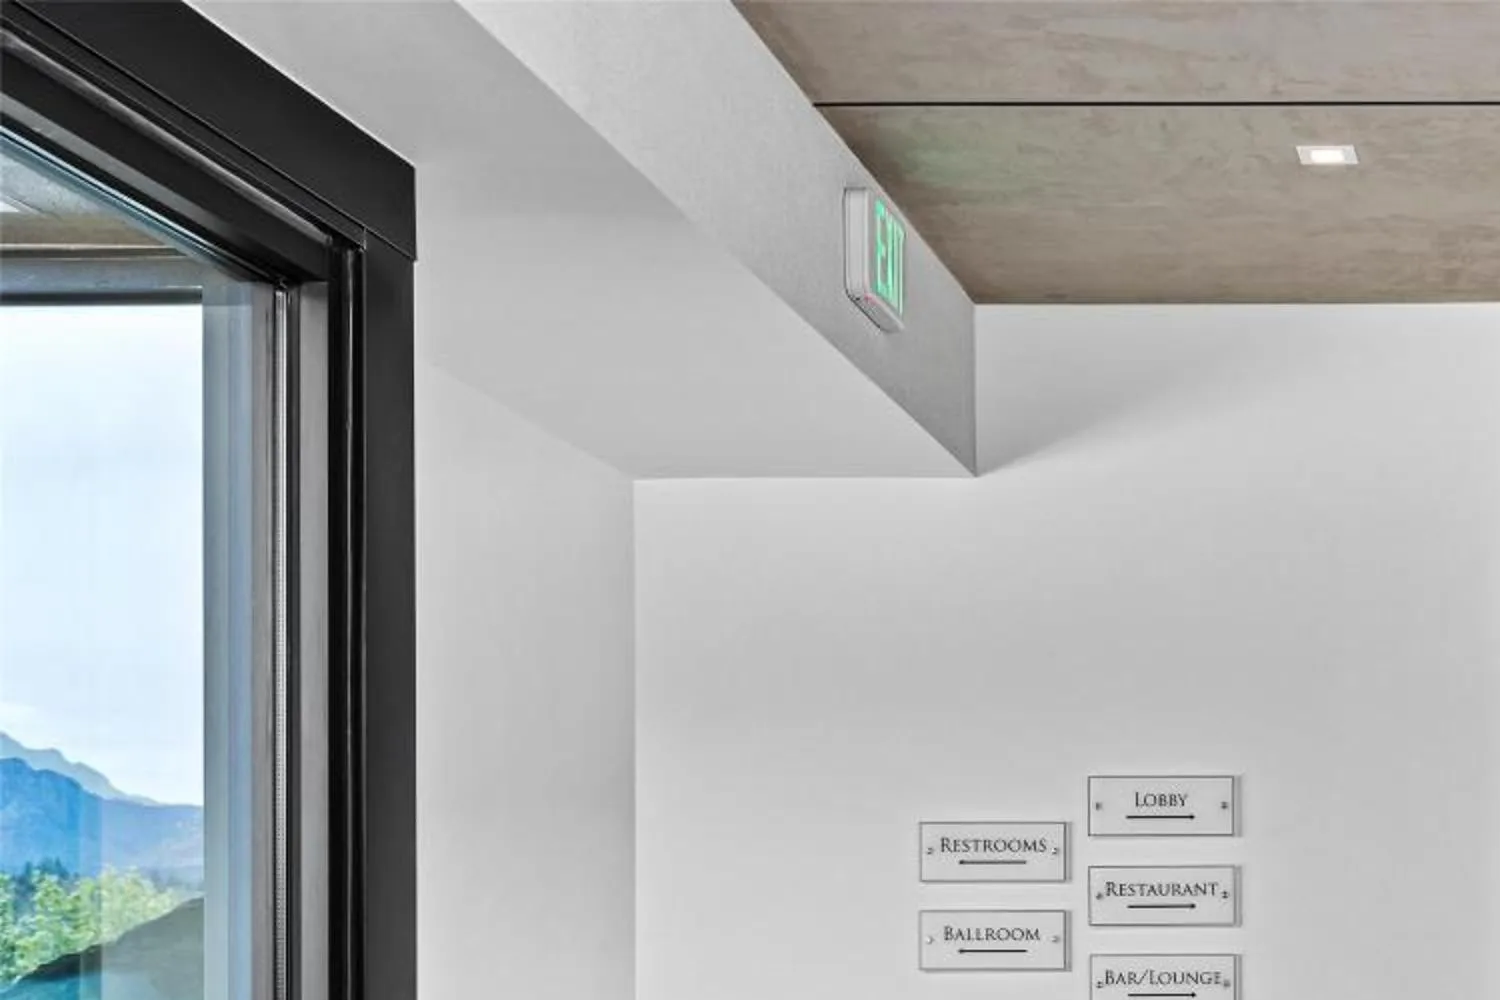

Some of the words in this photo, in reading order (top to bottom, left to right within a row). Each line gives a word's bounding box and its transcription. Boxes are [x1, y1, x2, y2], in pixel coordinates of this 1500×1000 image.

[1134, 792, 1189, 808] LOBBY
[940, 837, 1047, 853] RESTROOMS
[1105, 881, 1219, 898] RESTAURANT
[943, 926, 1041, 942] BALLROOM
[1104, 970, 1222, 987] BAR/LOUNGE
